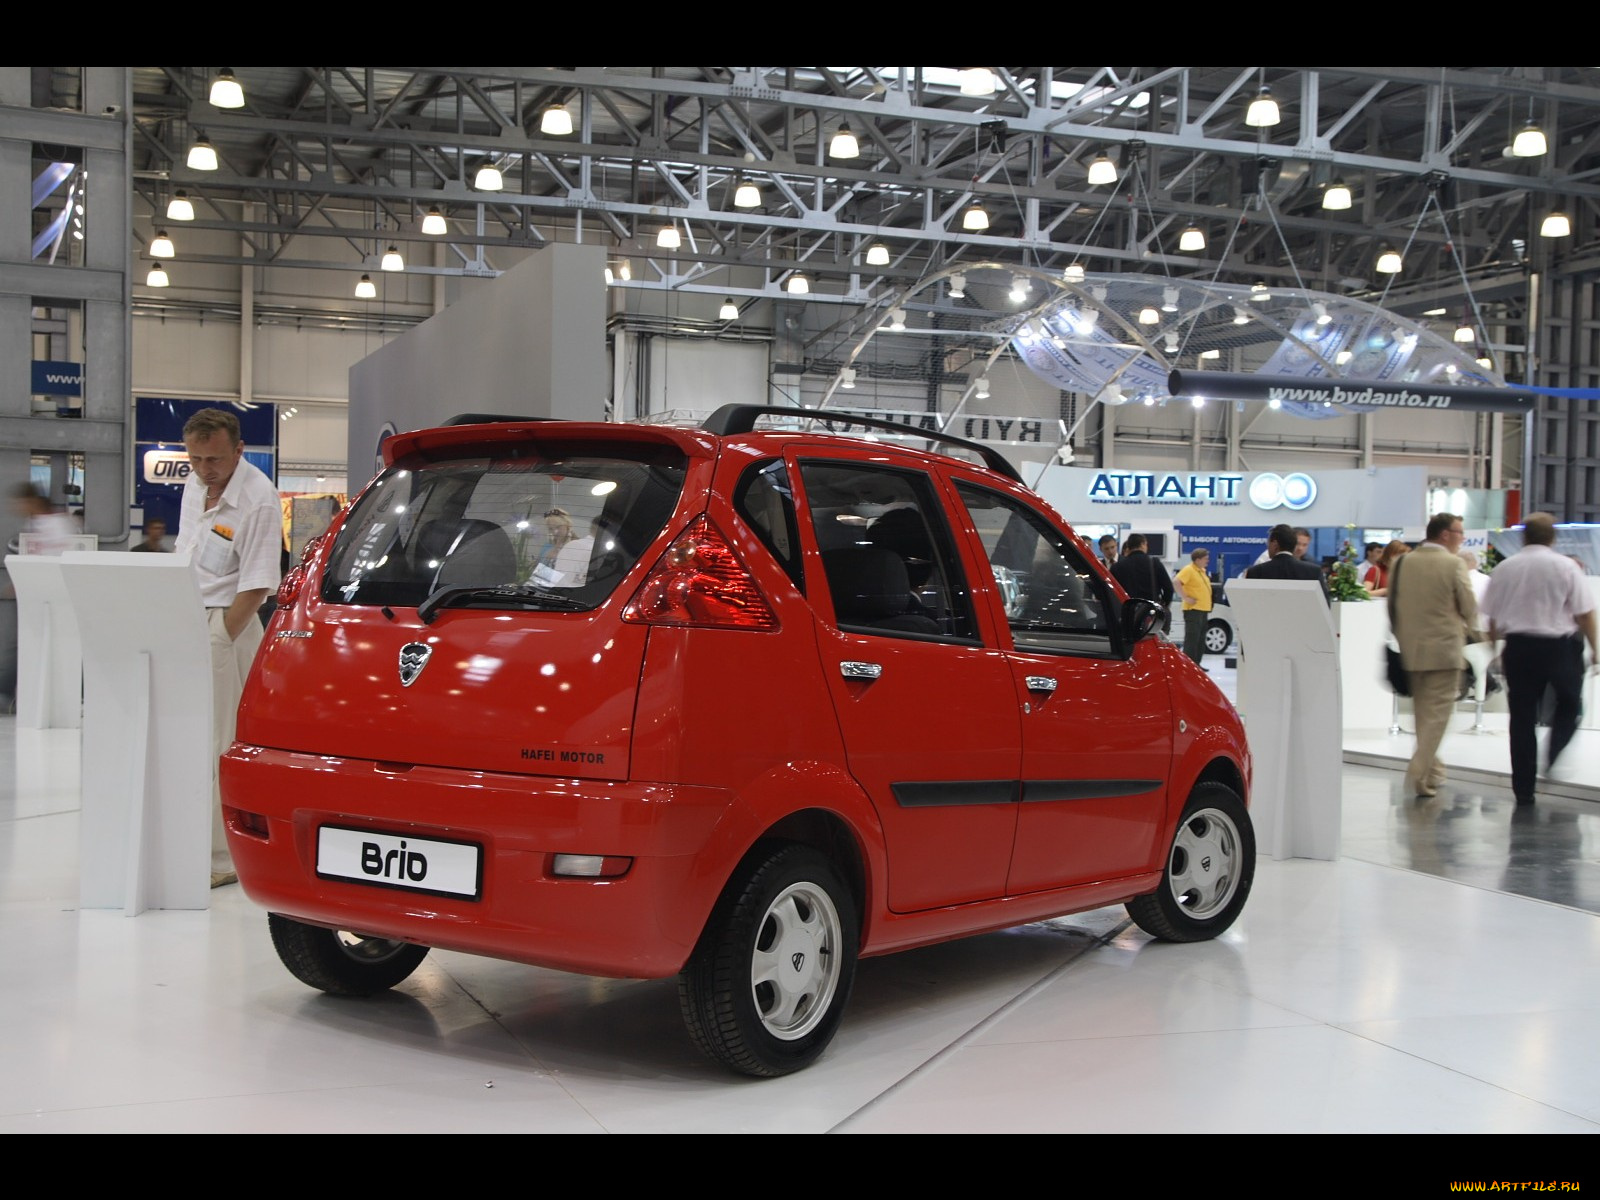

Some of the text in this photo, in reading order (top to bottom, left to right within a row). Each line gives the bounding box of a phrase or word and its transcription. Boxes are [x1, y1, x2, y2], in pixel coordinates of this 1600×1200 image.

[1269, 387, 1452, 408] www.bydauto.ru
[1089, 474, 1243, 499] АТЛАНТ
[521, 748, 605, 764] HAFEI MOTOR
[361, 840, 428, 882] Brio
